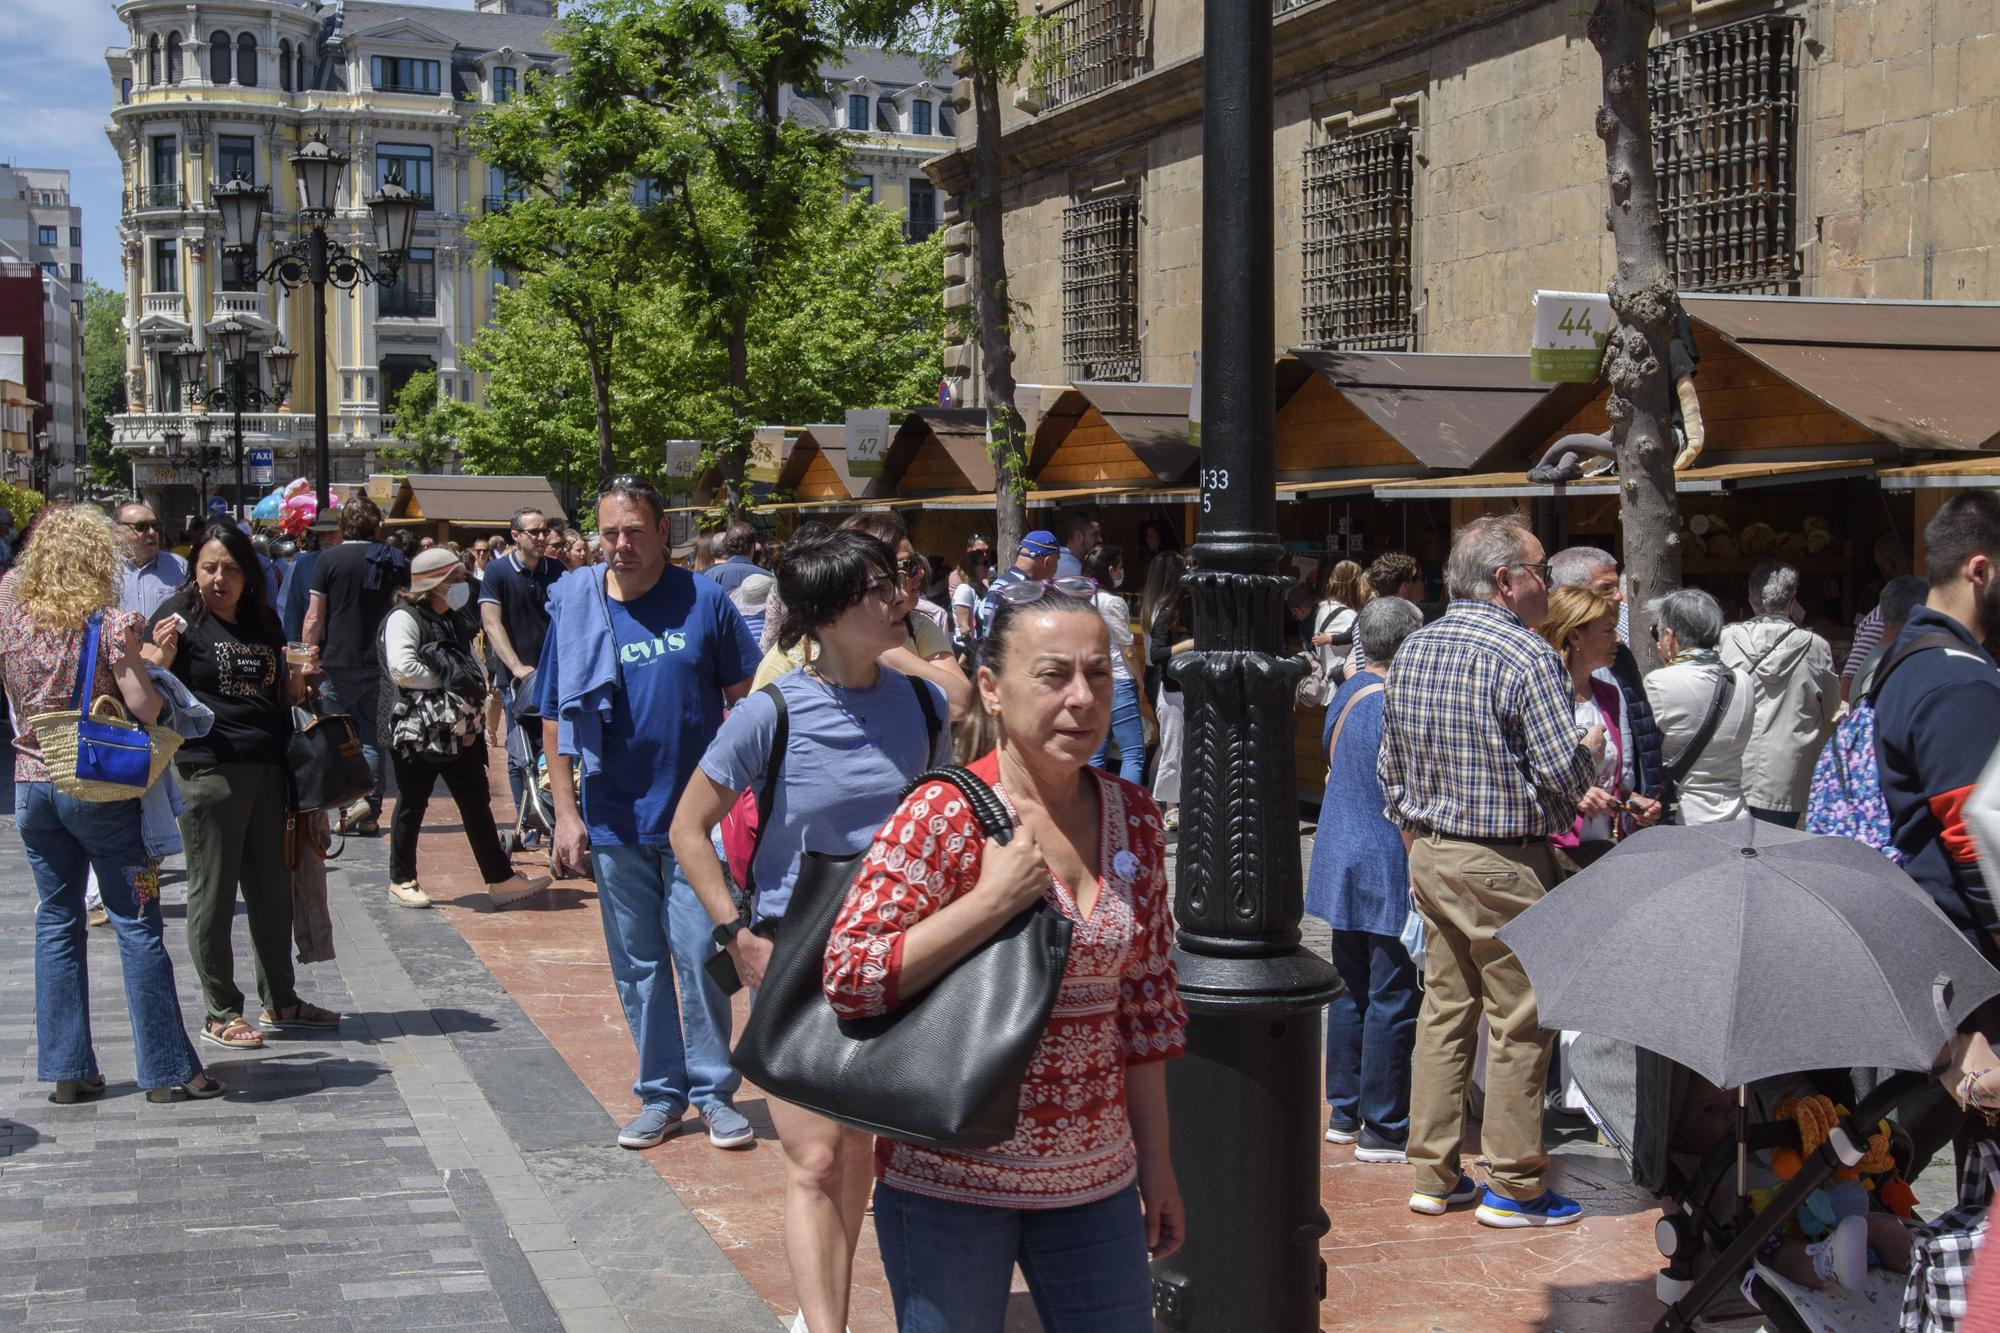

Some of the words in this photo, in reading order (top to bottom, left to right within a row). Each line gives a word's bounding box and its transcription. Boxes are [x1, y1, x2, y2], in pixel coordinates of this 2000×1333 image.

[1558, 306, 1592, 337] 44
[858, 437, 878, 454] 47
[250, 452, 272, 461] TAXI
[675, 461, 692, 472] 49
[620, 629, 686, 664] evi's
[237, 658, 261, 666] SAVAGE
